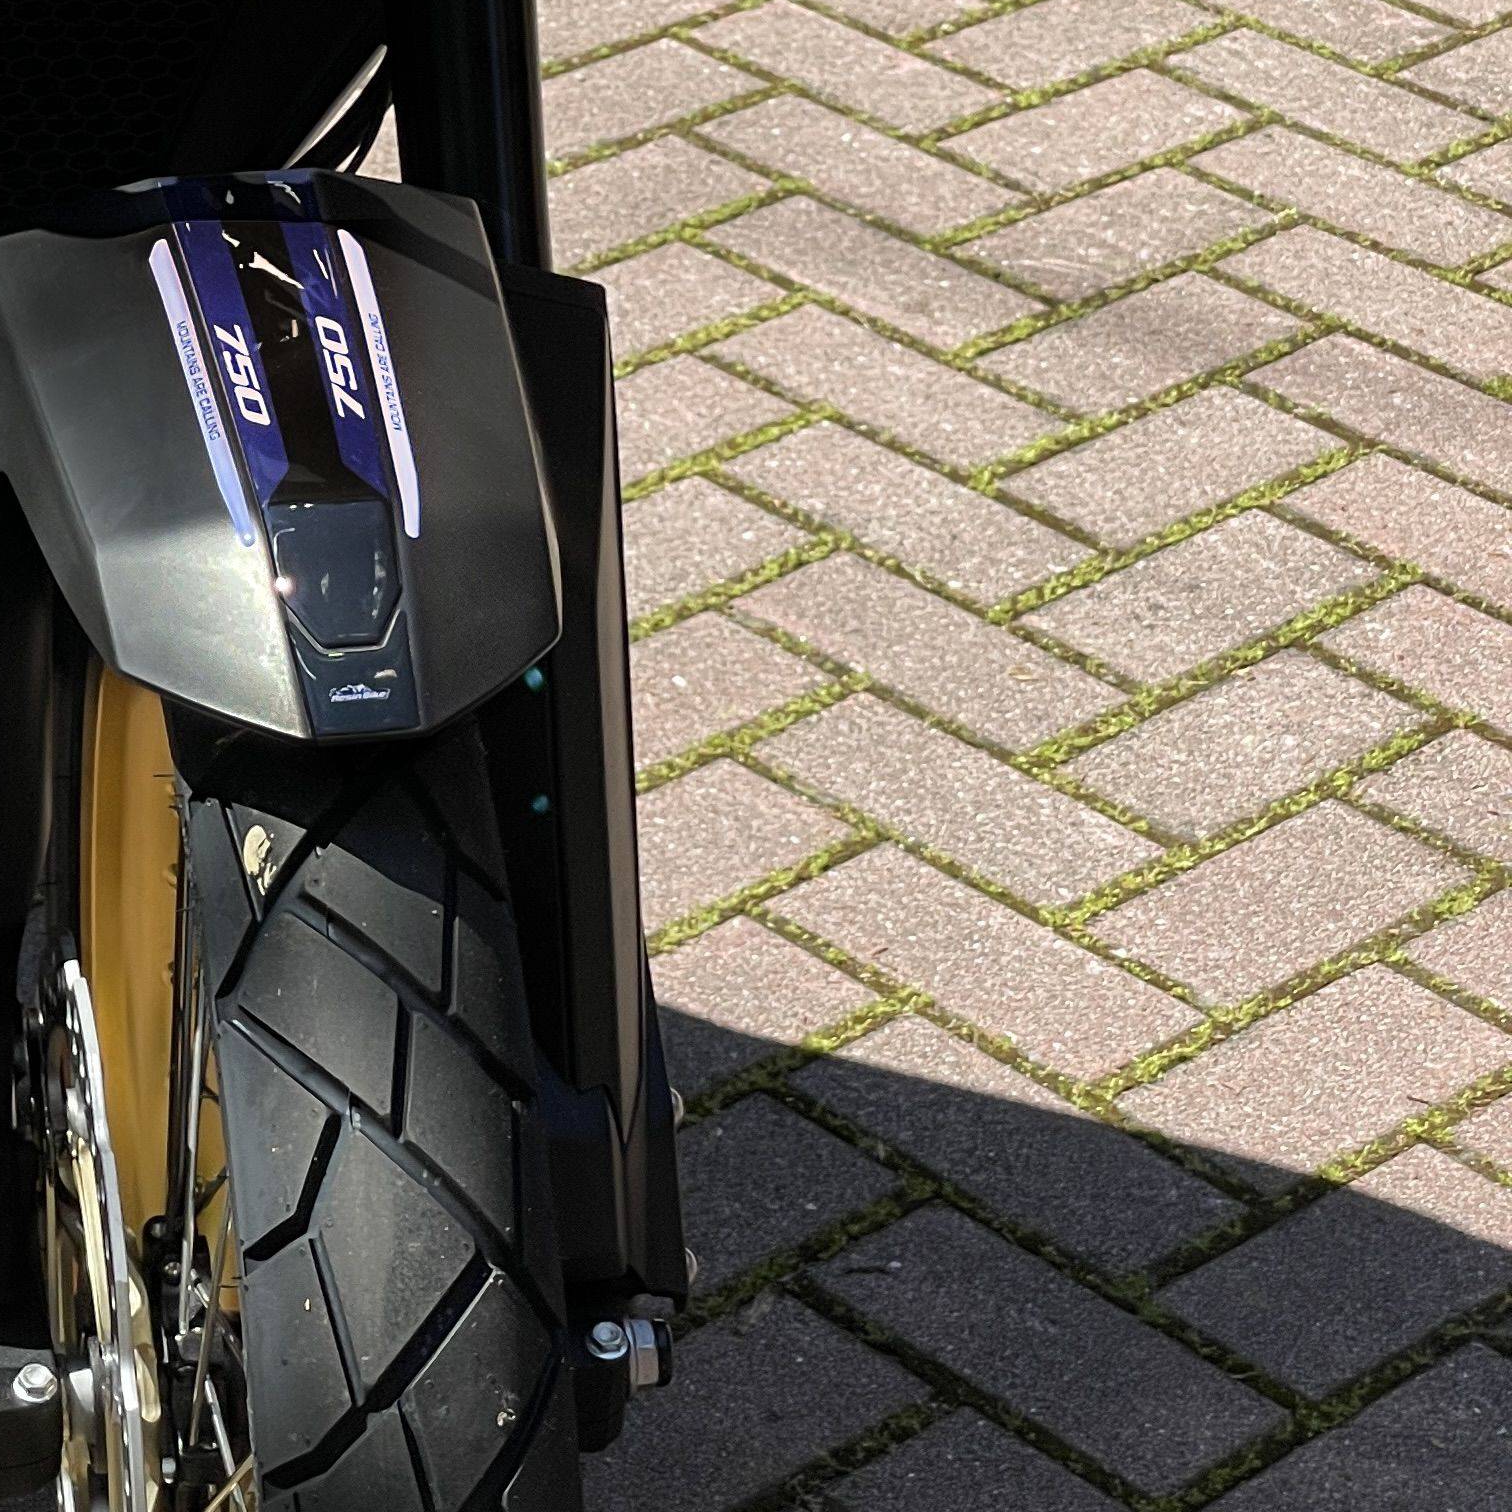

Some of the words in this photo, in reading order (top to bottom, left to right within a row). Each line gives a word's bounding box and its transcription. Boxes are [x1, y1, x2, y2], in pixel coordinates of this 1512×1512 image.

[176, 320, 200, 376] MOUNTAINS
[368, 312, 385, 352] CALLING
[192, 377, 207, 398] ARE
[213, 324, 271, 426] 750
[314, 315, 366, 420] 750
[377, 353, 389, 373] ARE
[199, 397, 221, 441] CALLING
[381, 374, 401, 431] MOUNTAINS
